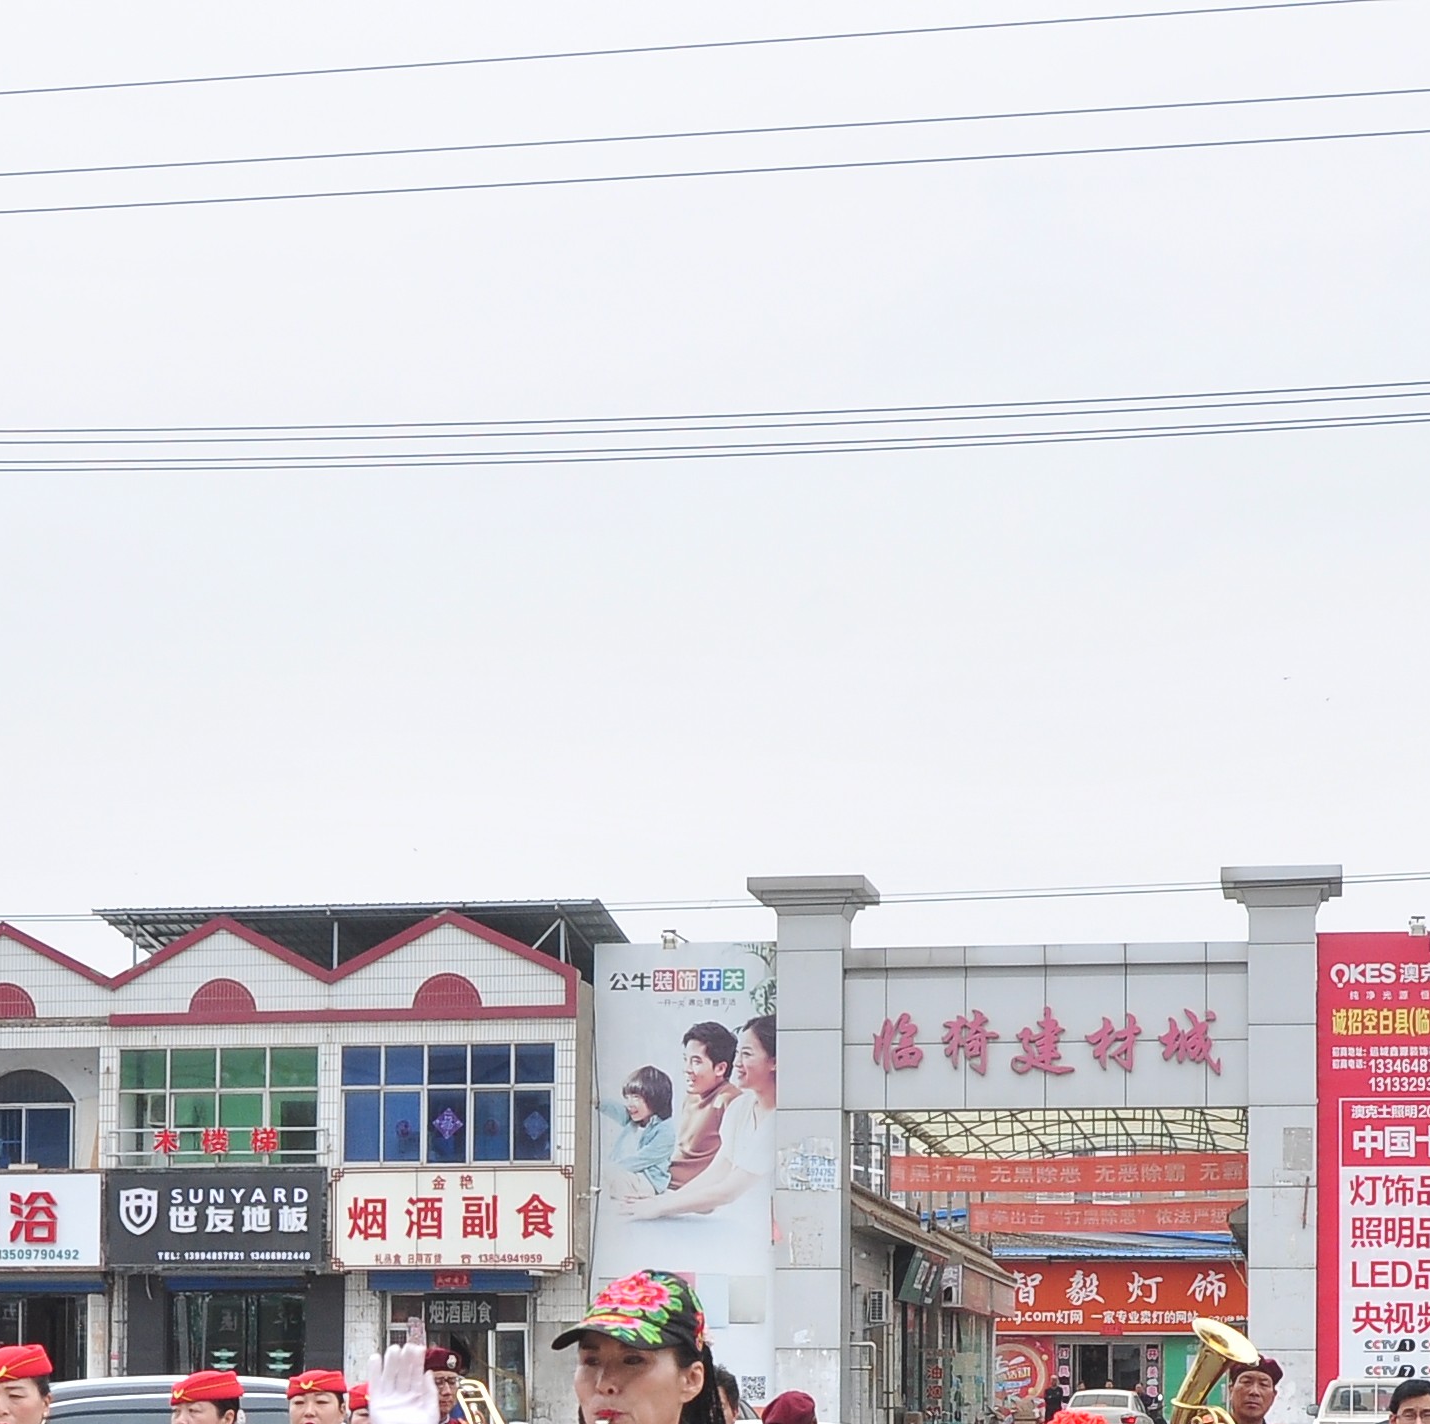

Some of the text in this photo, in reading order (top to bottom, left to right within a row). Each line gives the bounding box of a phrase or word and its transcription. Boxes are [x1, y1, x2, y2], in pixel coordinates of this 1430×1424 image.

[609, 970, 745, 991] 公牛装饰开关
[872, 1005, 1223, 1076] 临猗建材城
[154, 1127, 279, 1154] 木楼梯
[1200, 1161, 1249, 1182] 无霸
[171, 1188, 309, 1204] SUNYARD
[168, 1206, 308, 1234] 世友地板
[347, 1194, 557, 1241] 烟酒副食
[1012, 1269, 1228, 1307] 智毅灯饰
[429, 1300, 492, 1325] 烟酒副食
